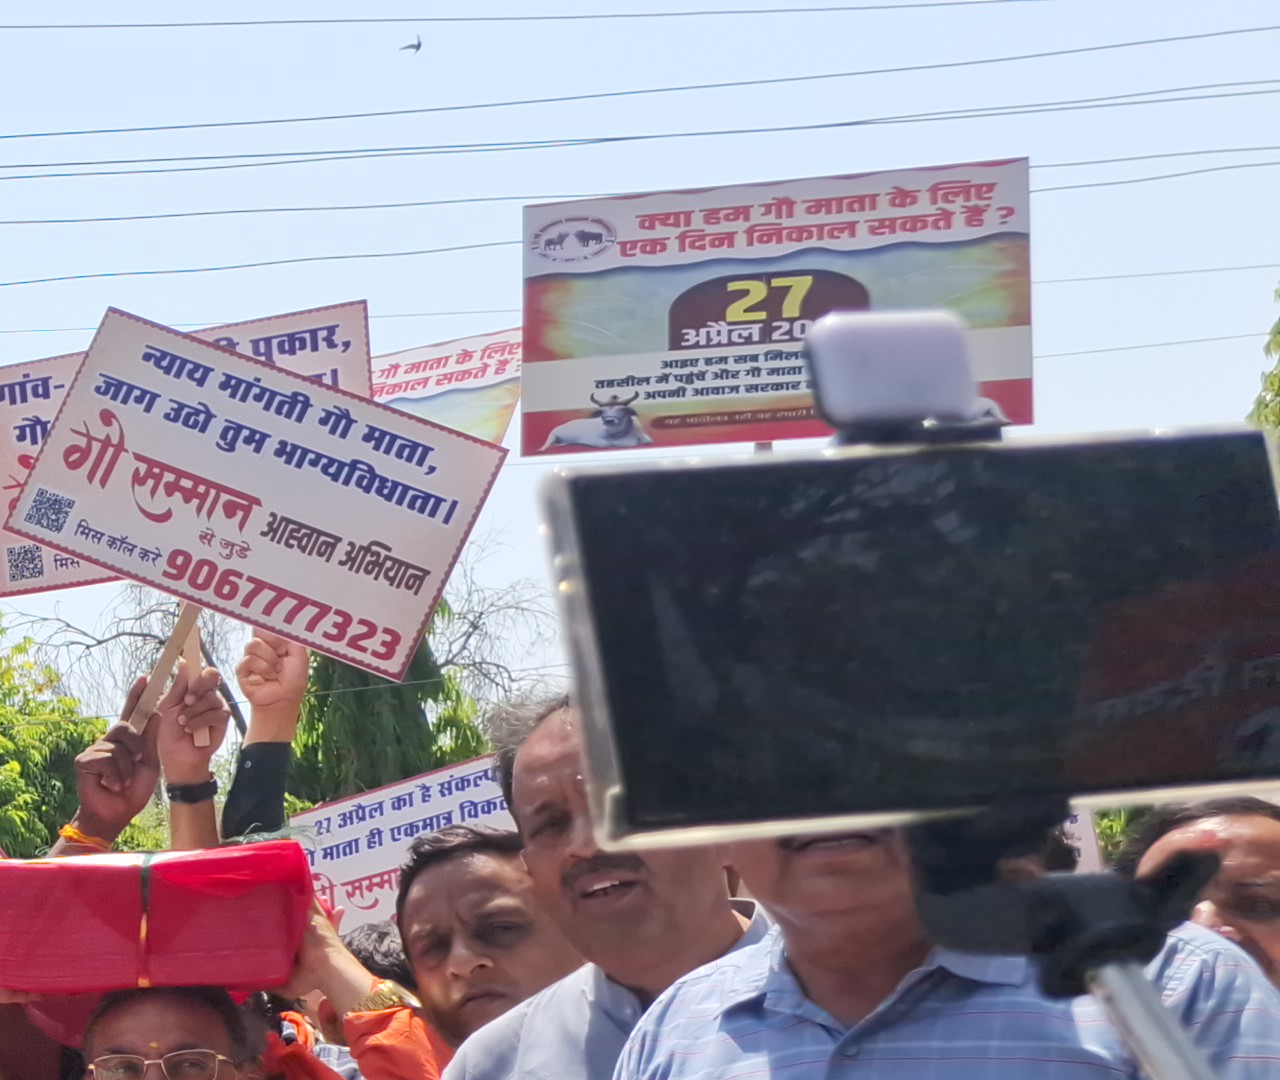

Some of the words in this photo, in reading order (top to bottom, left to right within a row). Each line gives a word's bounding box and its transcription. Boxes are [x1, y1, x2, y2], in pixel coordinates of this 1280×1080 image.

[617, 236, 670, 258] एक
[676, 229, 738, 252] दिन
[744, 222, 859, 247] निकाल
[865, 208, 954, 236] सकते
[958, 203, 990, 228] हैं
[997, 205, 1015, 225] ?
[635, 210, 694, 231] क्या
[699, 204, 755, 225] हम
[759, 197, 797, 220] गौ
[803, 193, 882, 215] माता
[884, 186, 921, 209] के
[927, 179, 999, 206] लिए
[725, 276, 813, 323] 27
[681, 321, 764, 346] अप्रैल
[771, 321, 810, 341] 20
[378, 363, 401, 380] गौ
[404, 355, 451, 376] माता
[455, 349, 477, 365] के
[480, 341, 521, 361] लिए
[435, 363, 491, 386] सकते
[94, 372, 161, 414] जाग
[215, 418, 272, 455] तुम
[141, 344, 215, 388] न्याय
[217, 375, 313, 424] मांगती
[318, 404, 357, 440] गौ
[361, 422, 438, 476] माता,
[63, 408, 129, 490] गौ
[131, 451, 263, 533] सम्मान
[338, 540, 431, 596] अभियान
[199, 528, 216, 546] से
[74, 519, 103, 545] मिस
[107, 534, 137, 556] कॉल
[161, 548, 402, 662] 9067777323
[315, 817, 332, 836] 27
[337, 803, 384, 829] अप्रैल
[391, 792, 414, 811] का
[416, 783, 432, 803] है
[320, 838, 361, 861] माता
[366, 828, 384, 850] ही
[390, 810, 453, 842] एकमात्र
